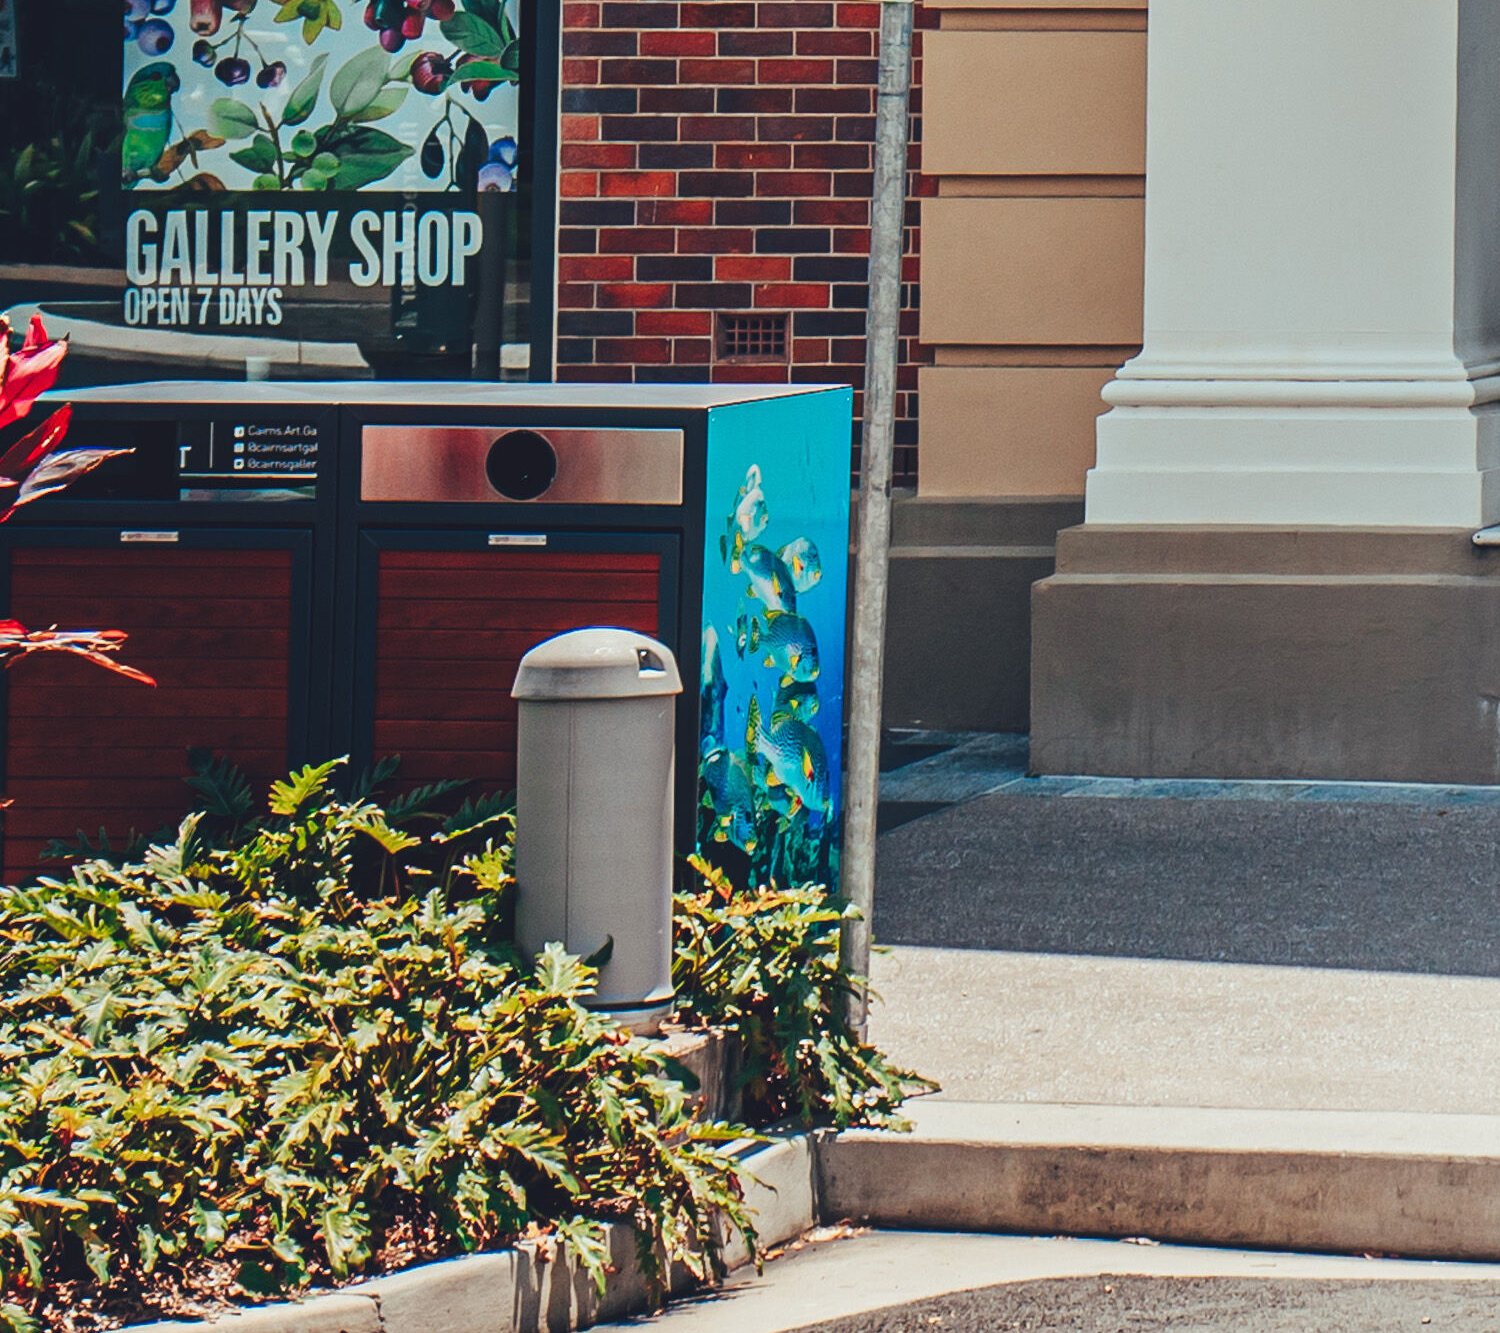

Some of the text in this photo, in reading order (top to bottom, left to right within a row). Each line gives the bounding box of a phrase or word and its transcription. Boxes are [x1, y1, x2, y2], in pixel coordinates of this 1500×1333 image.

[126, 209, 482, 286] GALLERY SHOP
[124, 287, 282, 326] OPEN 7 DAYS
